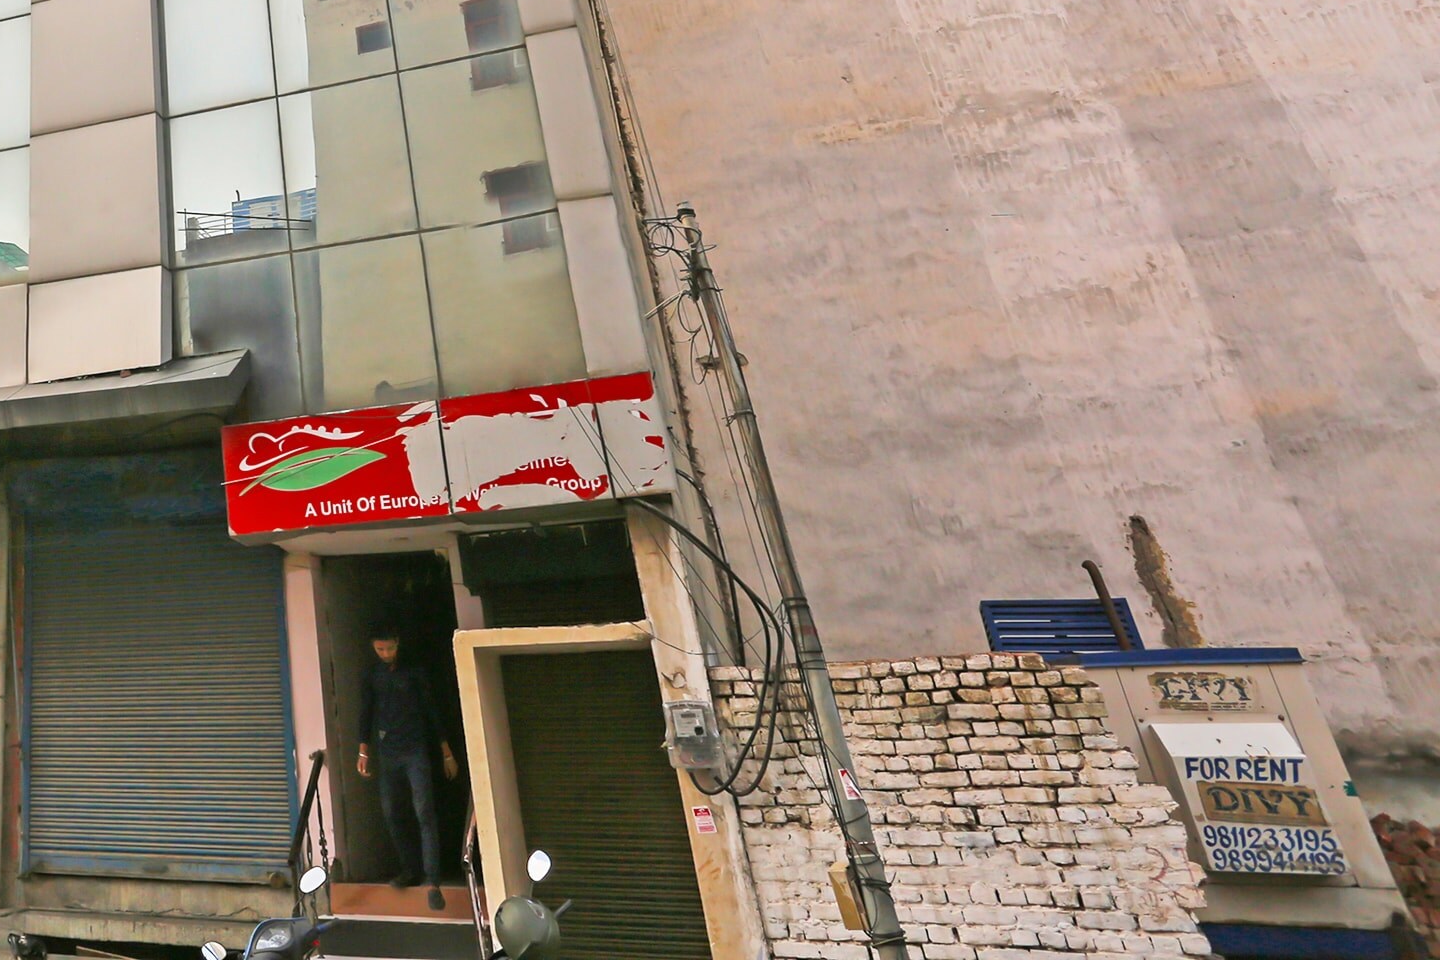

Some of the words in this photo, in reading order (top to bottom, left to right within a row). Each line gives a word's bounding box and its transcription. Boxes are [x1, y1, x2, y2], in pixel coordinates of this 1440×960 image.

[305, 502, 318, 518] A
[320, 499, 353, 516] Unit
[356, 495, 376, 512] Of
[380, 494, 441, 510] Europe
[546, 477, 602, 491] Group
[1184, 757, 1230, 780] FOR
[1235, 758, 1304, 783] RENT
[1203, 825, 1338, 853] 9811233195
